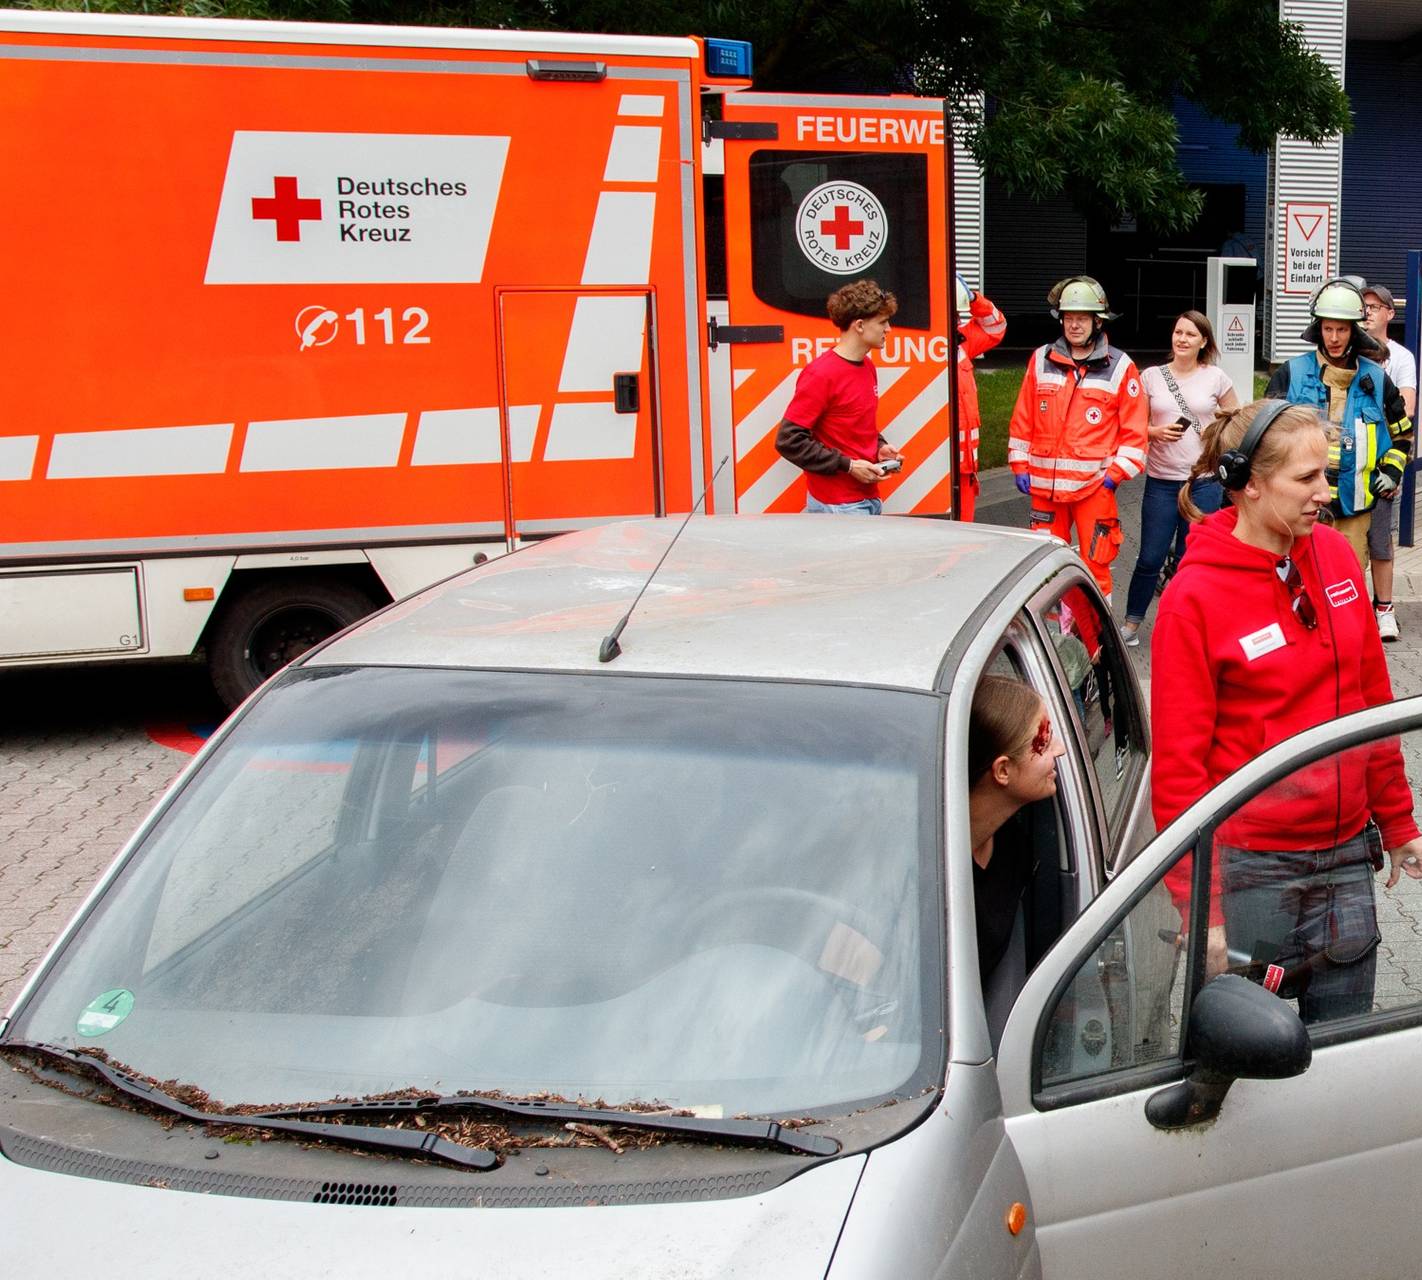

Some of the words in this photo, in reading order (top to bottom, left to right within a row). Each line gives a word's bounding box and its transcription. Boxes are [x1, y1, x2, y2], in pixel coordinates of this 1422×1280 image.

[797, 116, 944, 145] FEUERWE
[337, 177, 467, 196] Deutsches
[339, 200, 410, 219] Rotes
[806, 189, 878, 220] DEUTSCHES
[340, 223, 412, 242] Kreuz
[804, 230, 840, 266] ROTES
[845, 231, 880, 267] KREUZ
[1290, 248, 1324, 258] Vorsicht
[1293, 261, 1305, 270] bei
[1308, 261, 1321, 270] der
[1290, 273, 1323, 283] Einfahrt
[345, 307, 431, 345] 112
[792, 336, 948, 365] REUNG
[120, 635, 138, 645] G1
[102, 991, 125, 1013] 4
